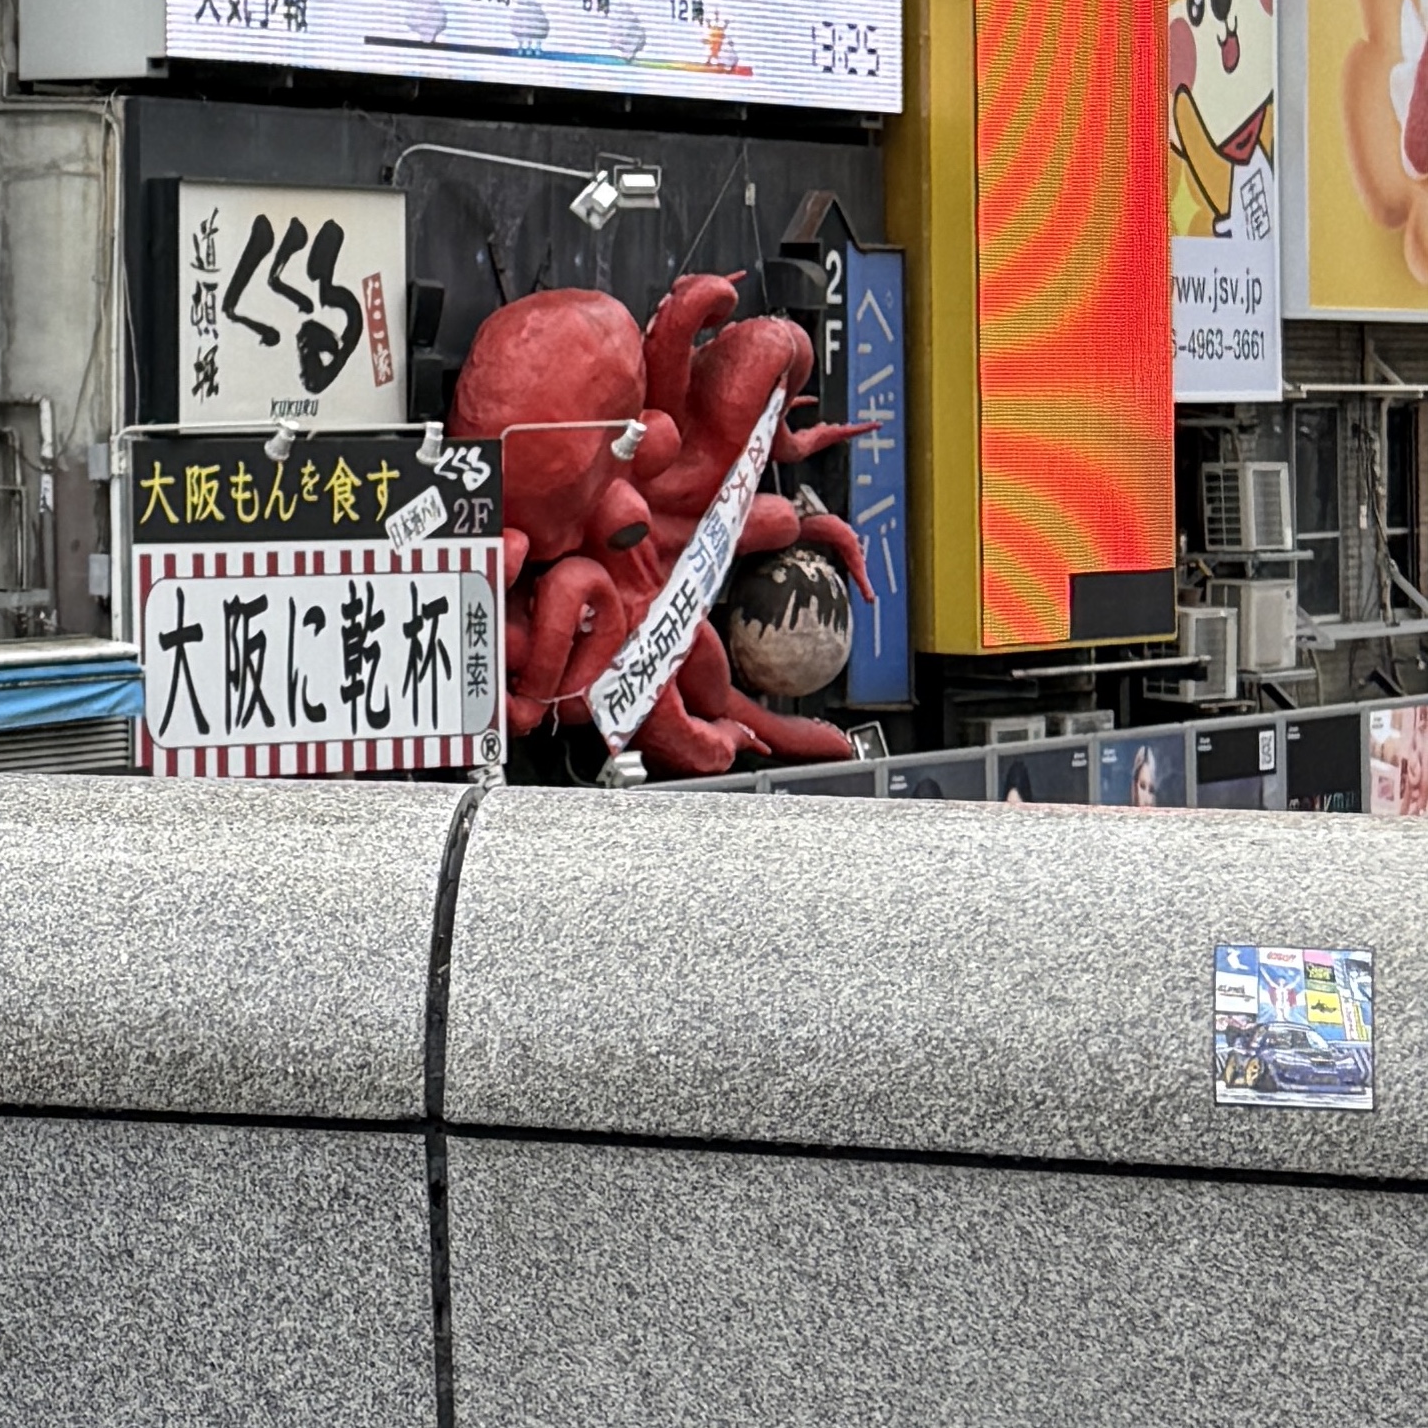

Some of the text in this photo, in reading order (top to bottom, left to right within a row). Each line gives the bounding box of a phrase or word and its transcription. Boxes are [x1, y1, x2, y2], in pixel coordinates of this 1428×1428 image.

[190, 207, 221, 405] 道頓堀
[139, 458, 401, 525] 大阪もんを食す
[453, 497, 495, 534] 2F
[157, 579, 453, 739] 大阪に乾杯
[465, 601, 489, 699] 検索
[603, 578, 700, 724] 出店決定
